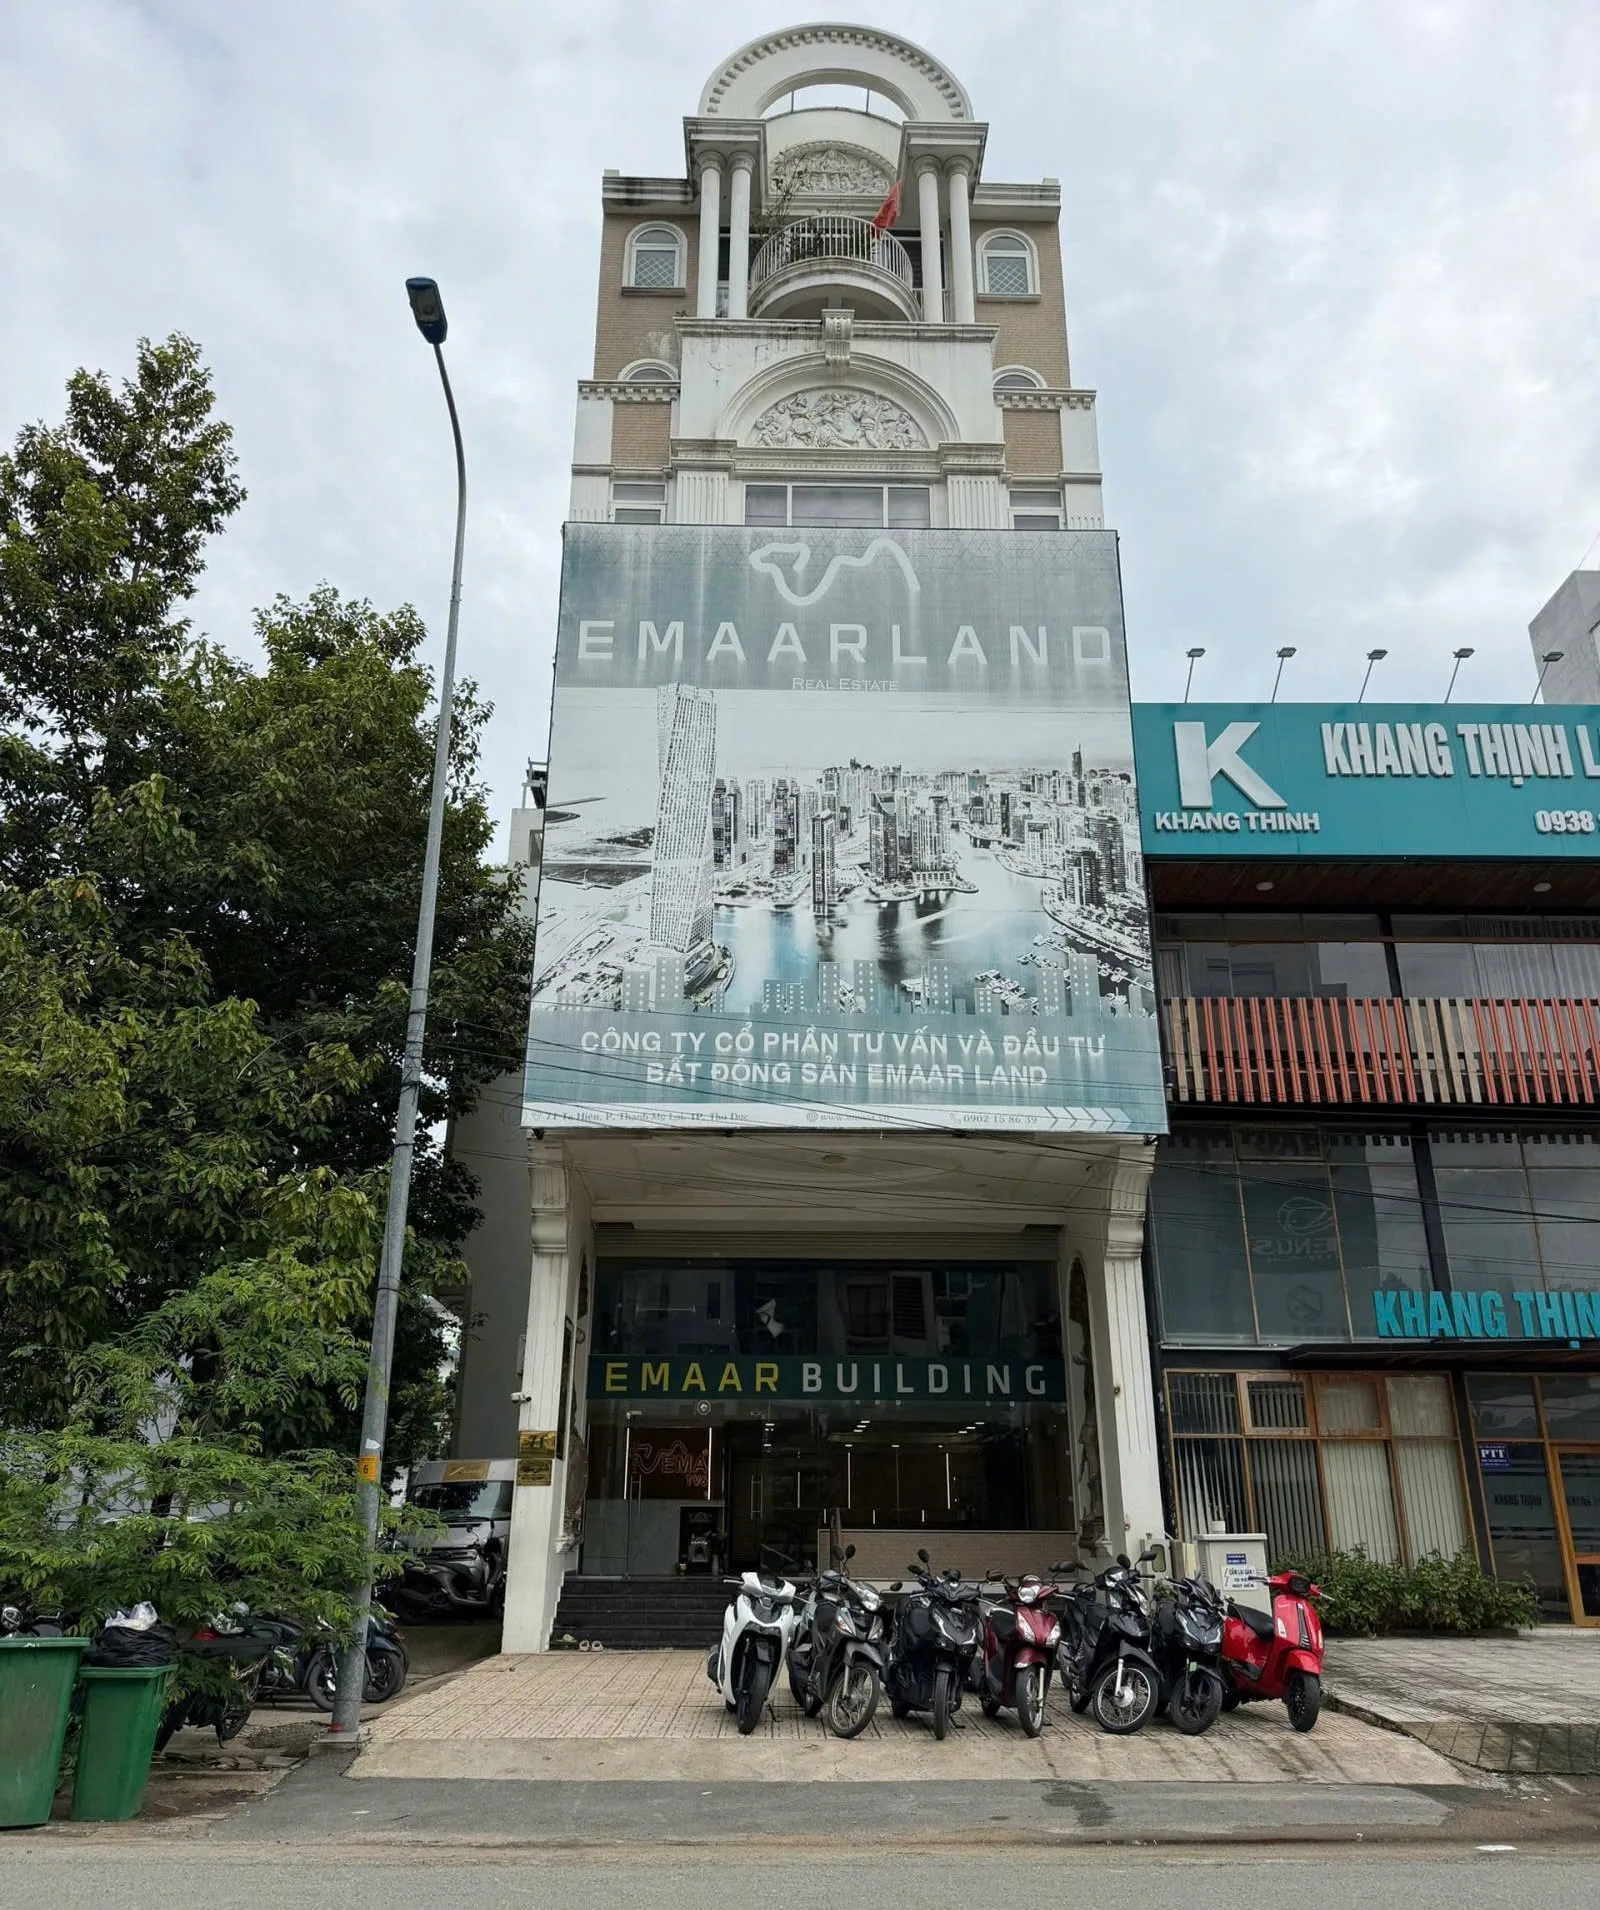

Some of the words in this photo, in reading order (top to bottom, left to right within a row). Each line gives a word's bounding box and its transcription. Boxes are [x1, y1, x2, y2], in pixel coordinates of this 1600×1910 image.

[1174, 721, 1288, 809] K
[1320, 721, 1454, 777] KHANG
[1456, 722, 1574, 787] THỊNH
[1154, 811, 1241, 832] KHANG
[1243, 812, 1321, 832] THINH
[1534, 809, 1596, 833] 0938
[581, 1026, 661, 1052] CÔNG
[671, 1031, 706, 1053] TY
[714, 1022, 755, 1053] CỔ
[763, 1024, 838, 1054] PHẦN
[847, 1030, 885, 1054] TƯ
[891, 1025, 947, 1055] VẤN
[956, 1028, 994, 1055] VÀ
[1002, 1026, 1060, 1056] ĐẦU
[1068, 1033, 1106, 1057] TƯ
[646, 1055, 702, 1083] BẤT
[800, 1055, 857, 1084] SẢN
[867, 1063, 964, 1085] EMAAR
[974, 1064, 1048, 1086] LAND
[963, 1113, 990, 1123] 0902
[994, 1114, 1006, 1123] 15
[1373, 1289, 1508, 1338] KHANG
[605, 1362, 780, 1392] EMAAR
[802, 1363, 1047, 1395] BUILDING
